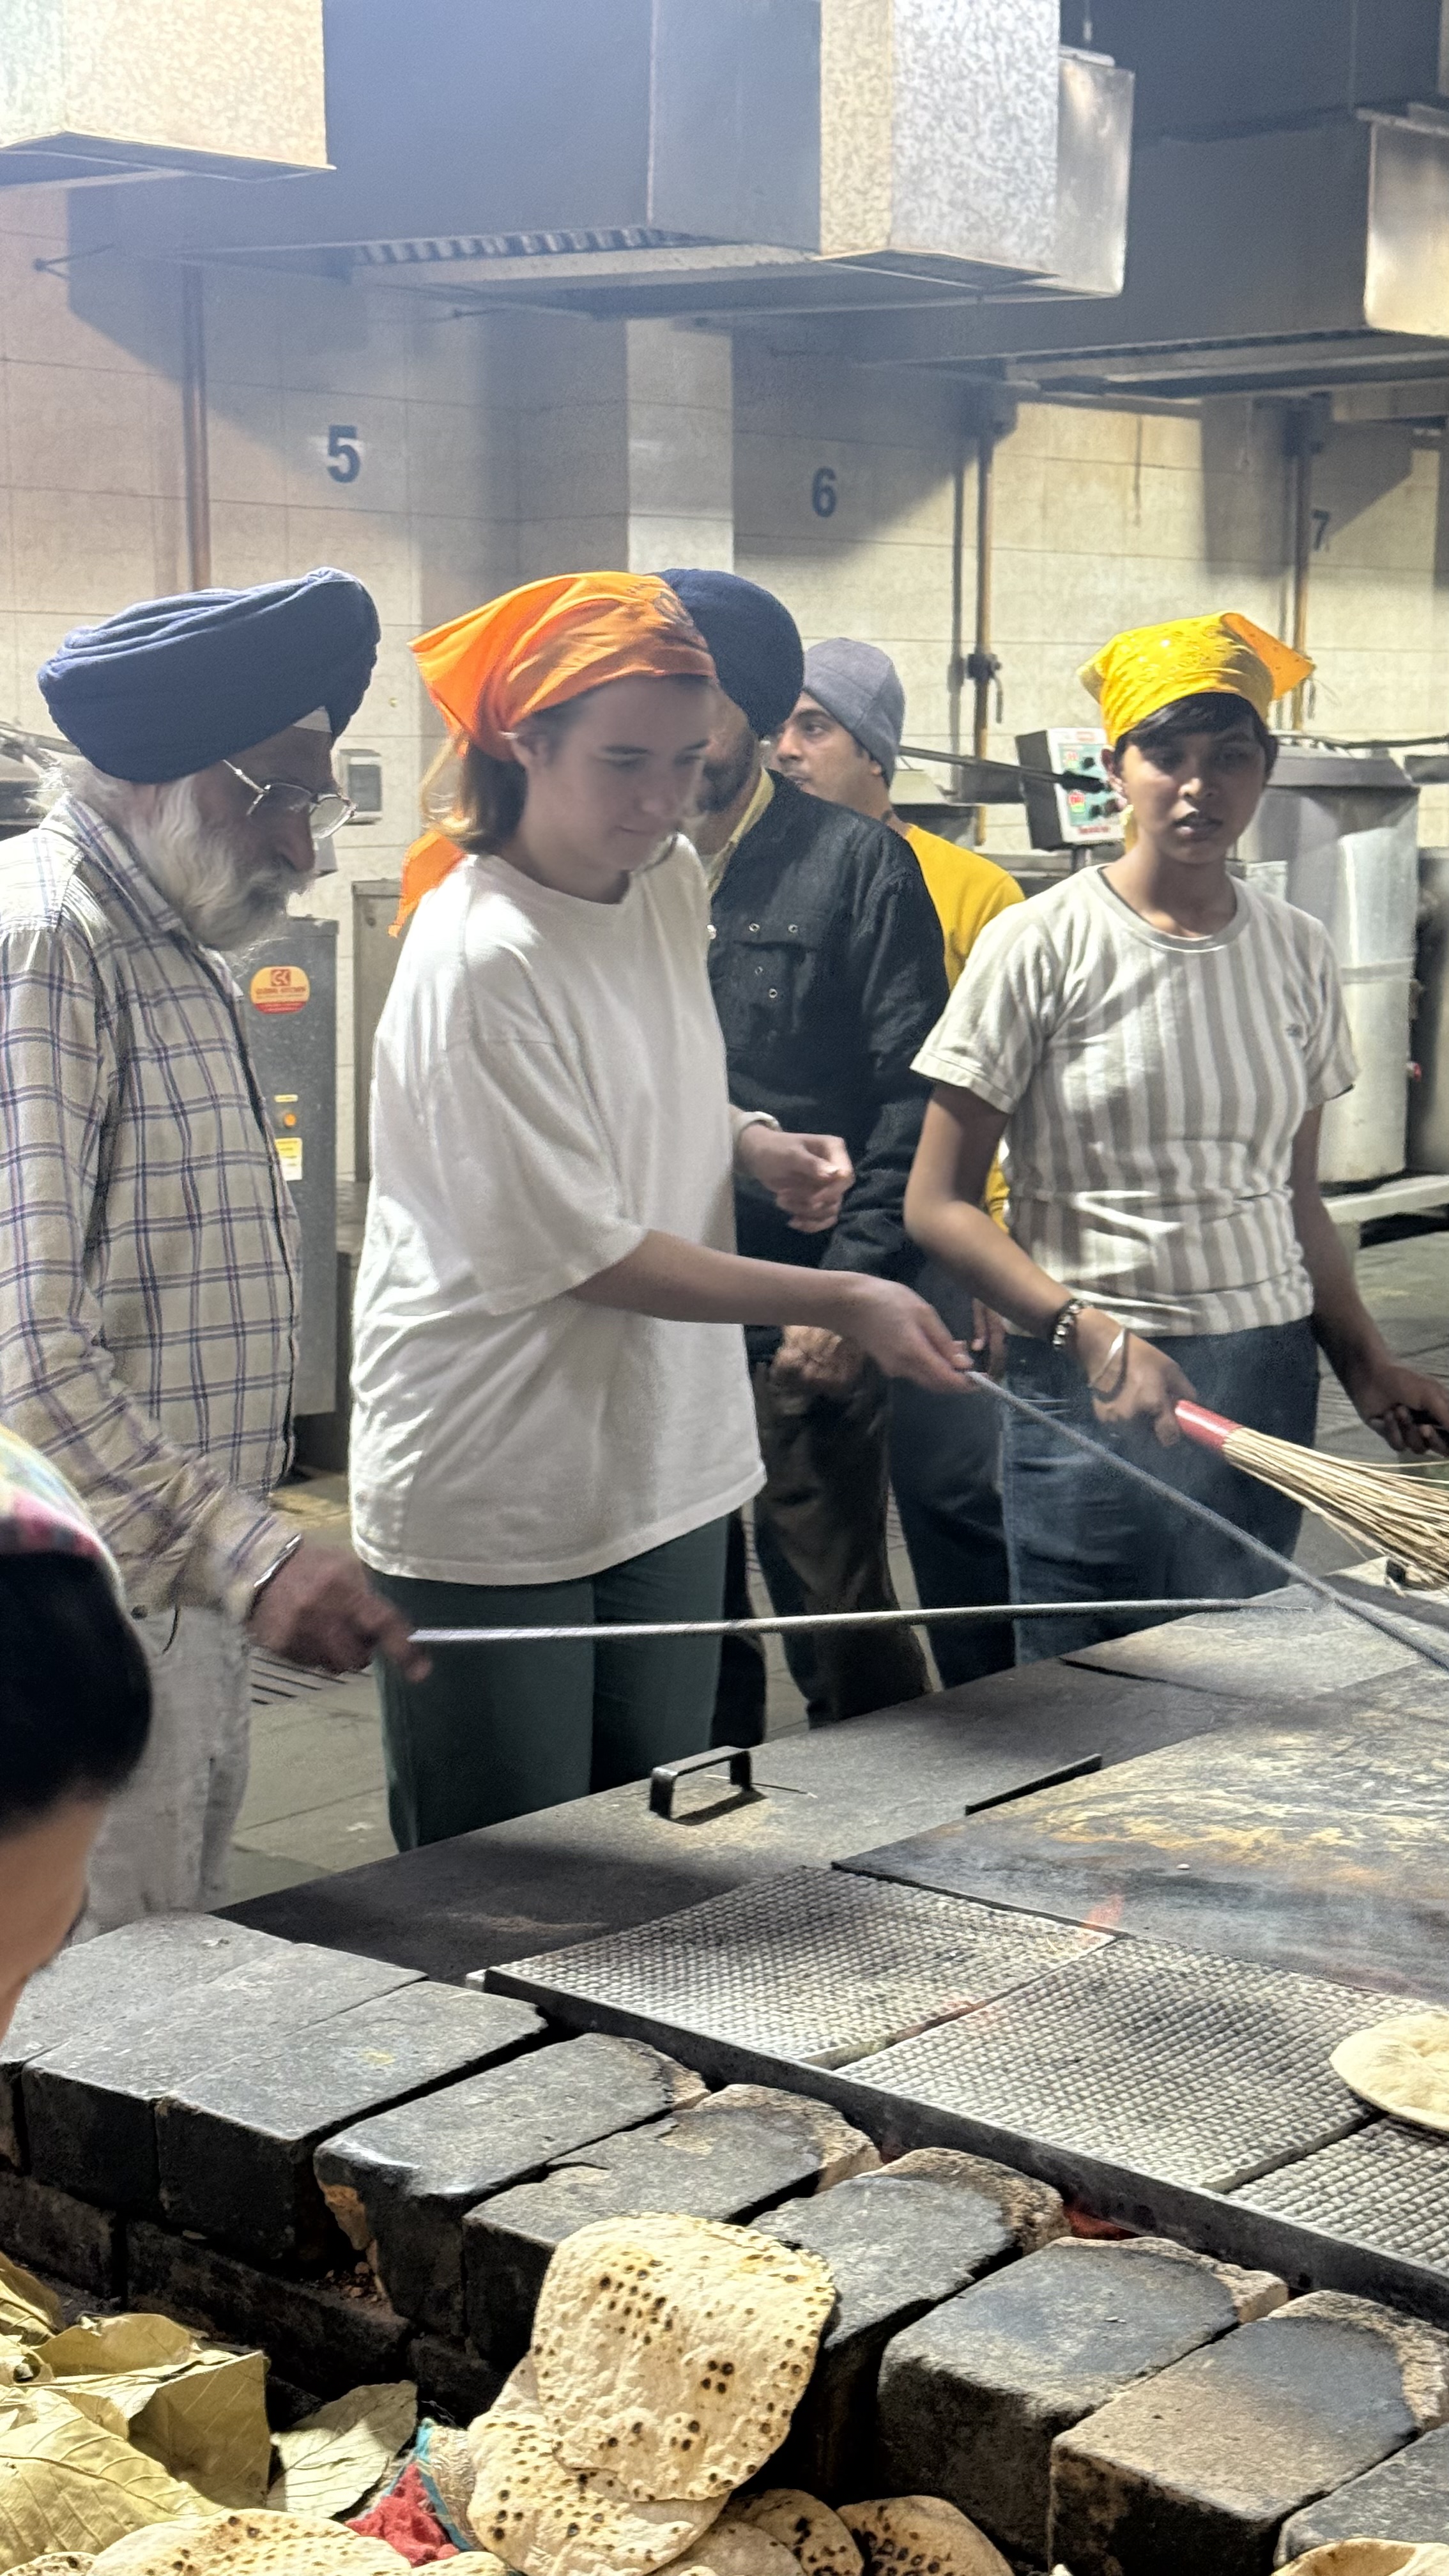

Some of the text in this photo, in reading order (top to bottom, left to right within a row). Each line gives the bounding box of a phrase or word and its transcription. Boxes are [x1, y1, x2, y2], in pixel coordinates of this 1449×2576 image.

[326, 424, 360, 484] 5
[812, 466, 836, 518] 6
[1312, 509, 1330, 551] 7
